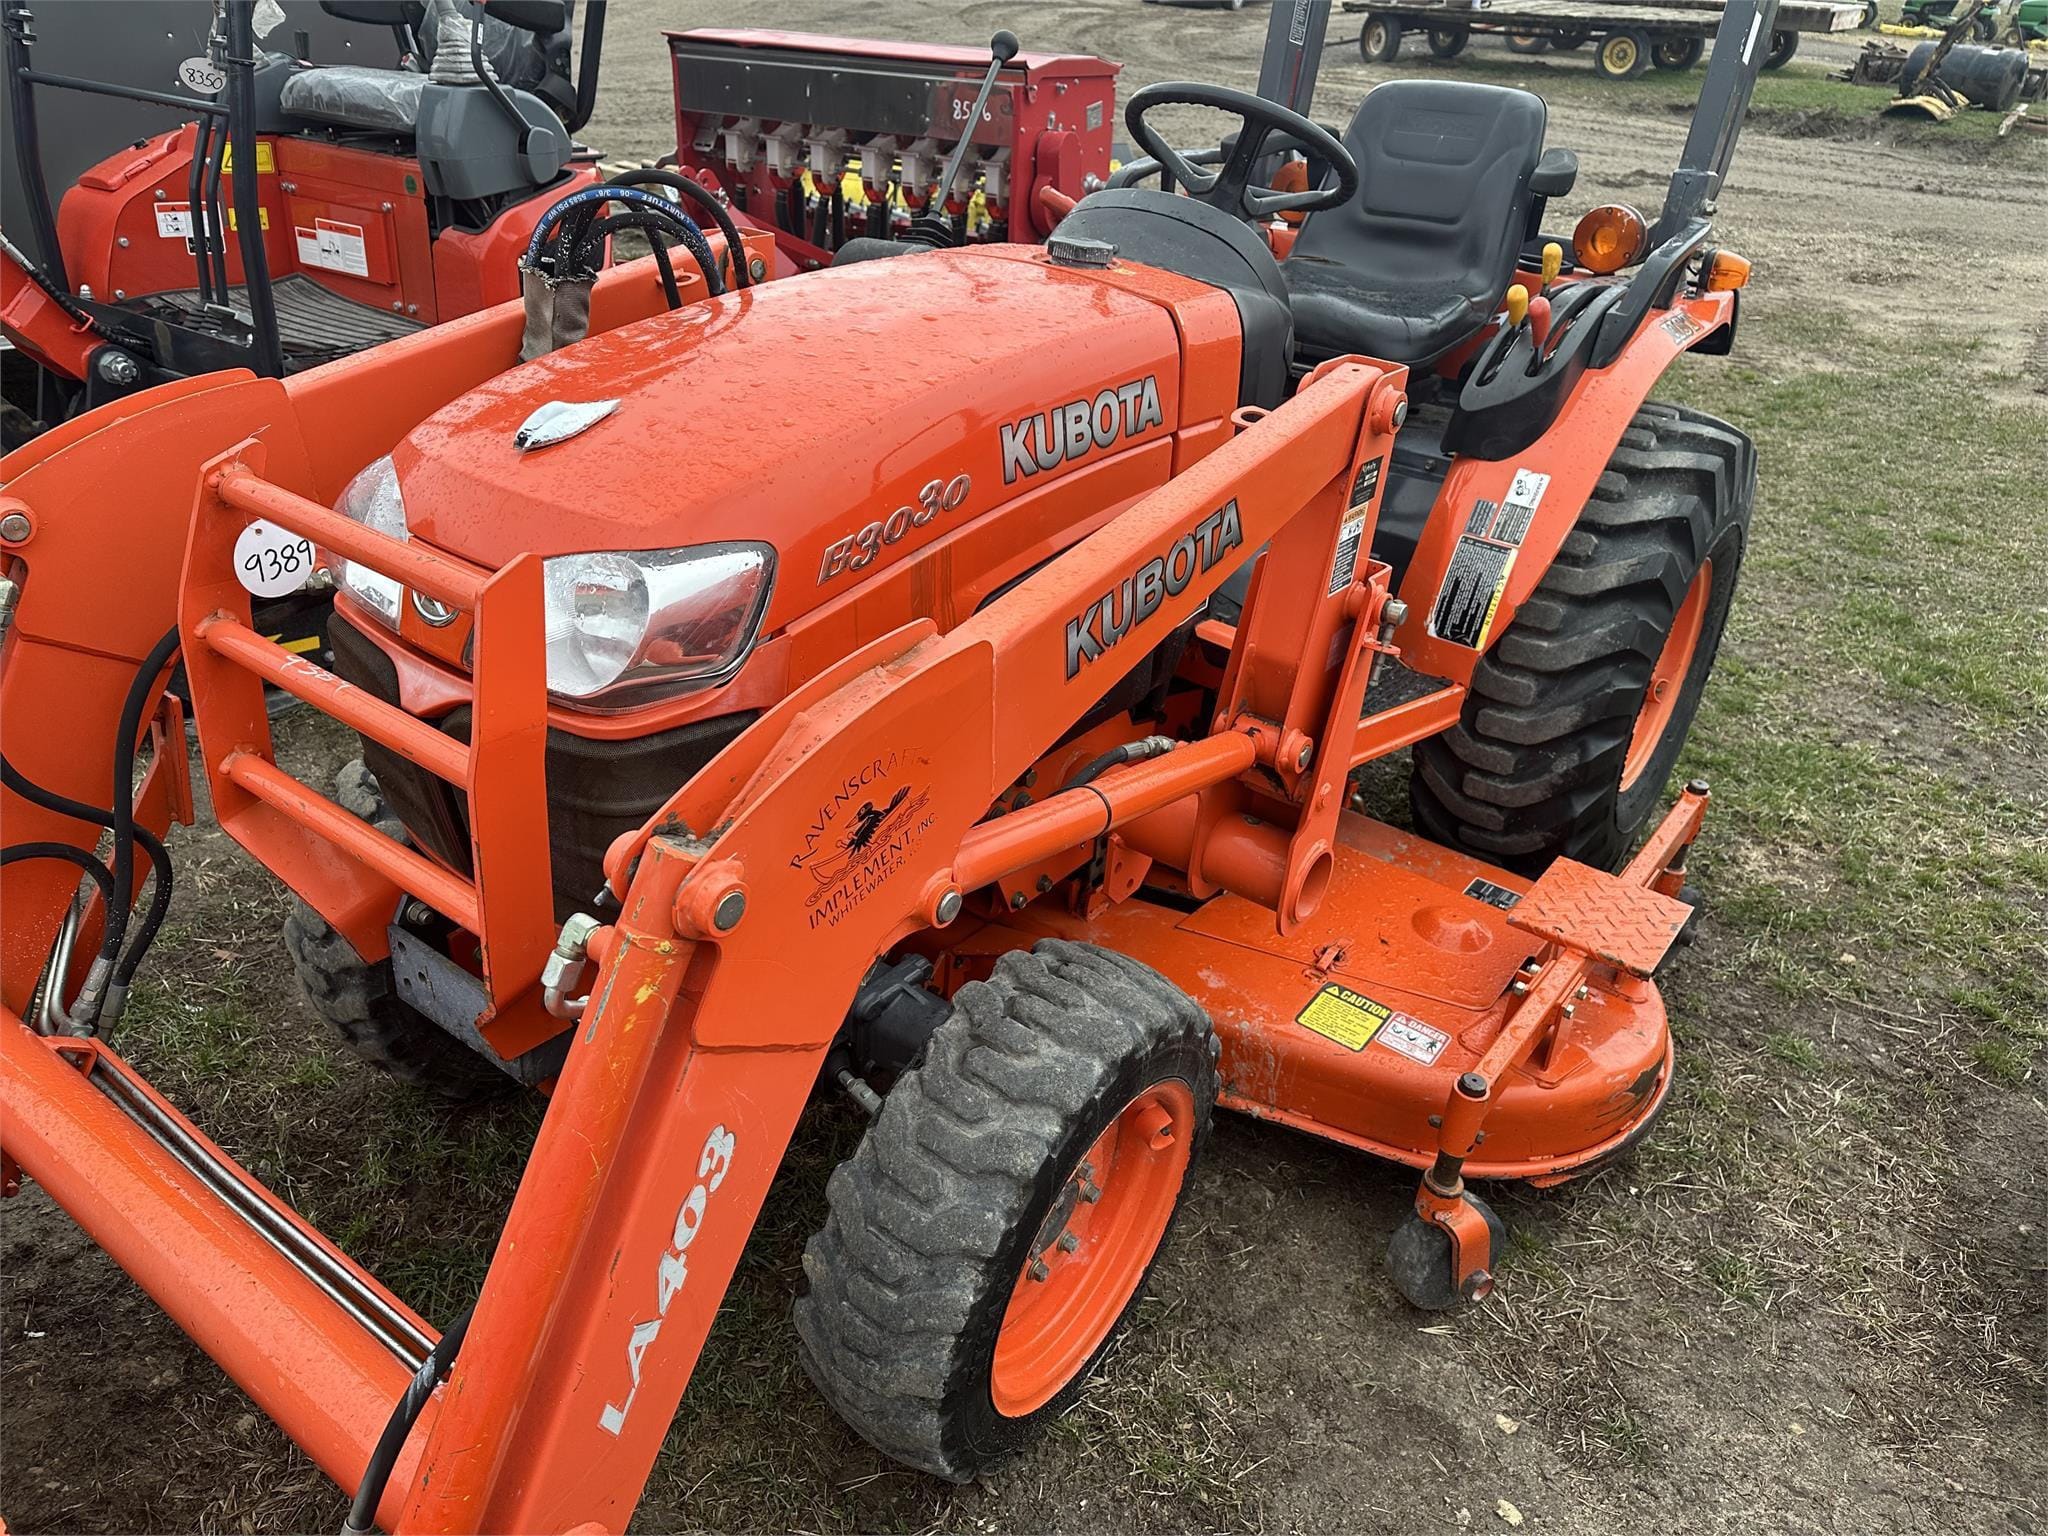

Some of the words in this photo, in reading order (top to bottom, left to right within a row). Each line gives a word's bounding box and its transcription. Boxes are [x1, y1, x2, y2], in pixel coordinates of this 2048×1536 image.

[186, 67, 223, 90] 8350
[952, 99, 992, 121] 856
[640, 194, 664, 207] TUFF
[664, 203, 685, 221] KURT
[1000, 375, 1163, 485] KUBOTA
[817, 474, 972, 587] B3030
[244, 539, 313, 583] 9389
[1065, 497, 1244, 681] KUBOTA
[1484, 579, 1506, 627] CAUTION
[1340, 990, 1391, 1019] CAUTION
[1407, 1020, 1447, 1042] DANGER
[598, 1124, 736, 1437] LA403
